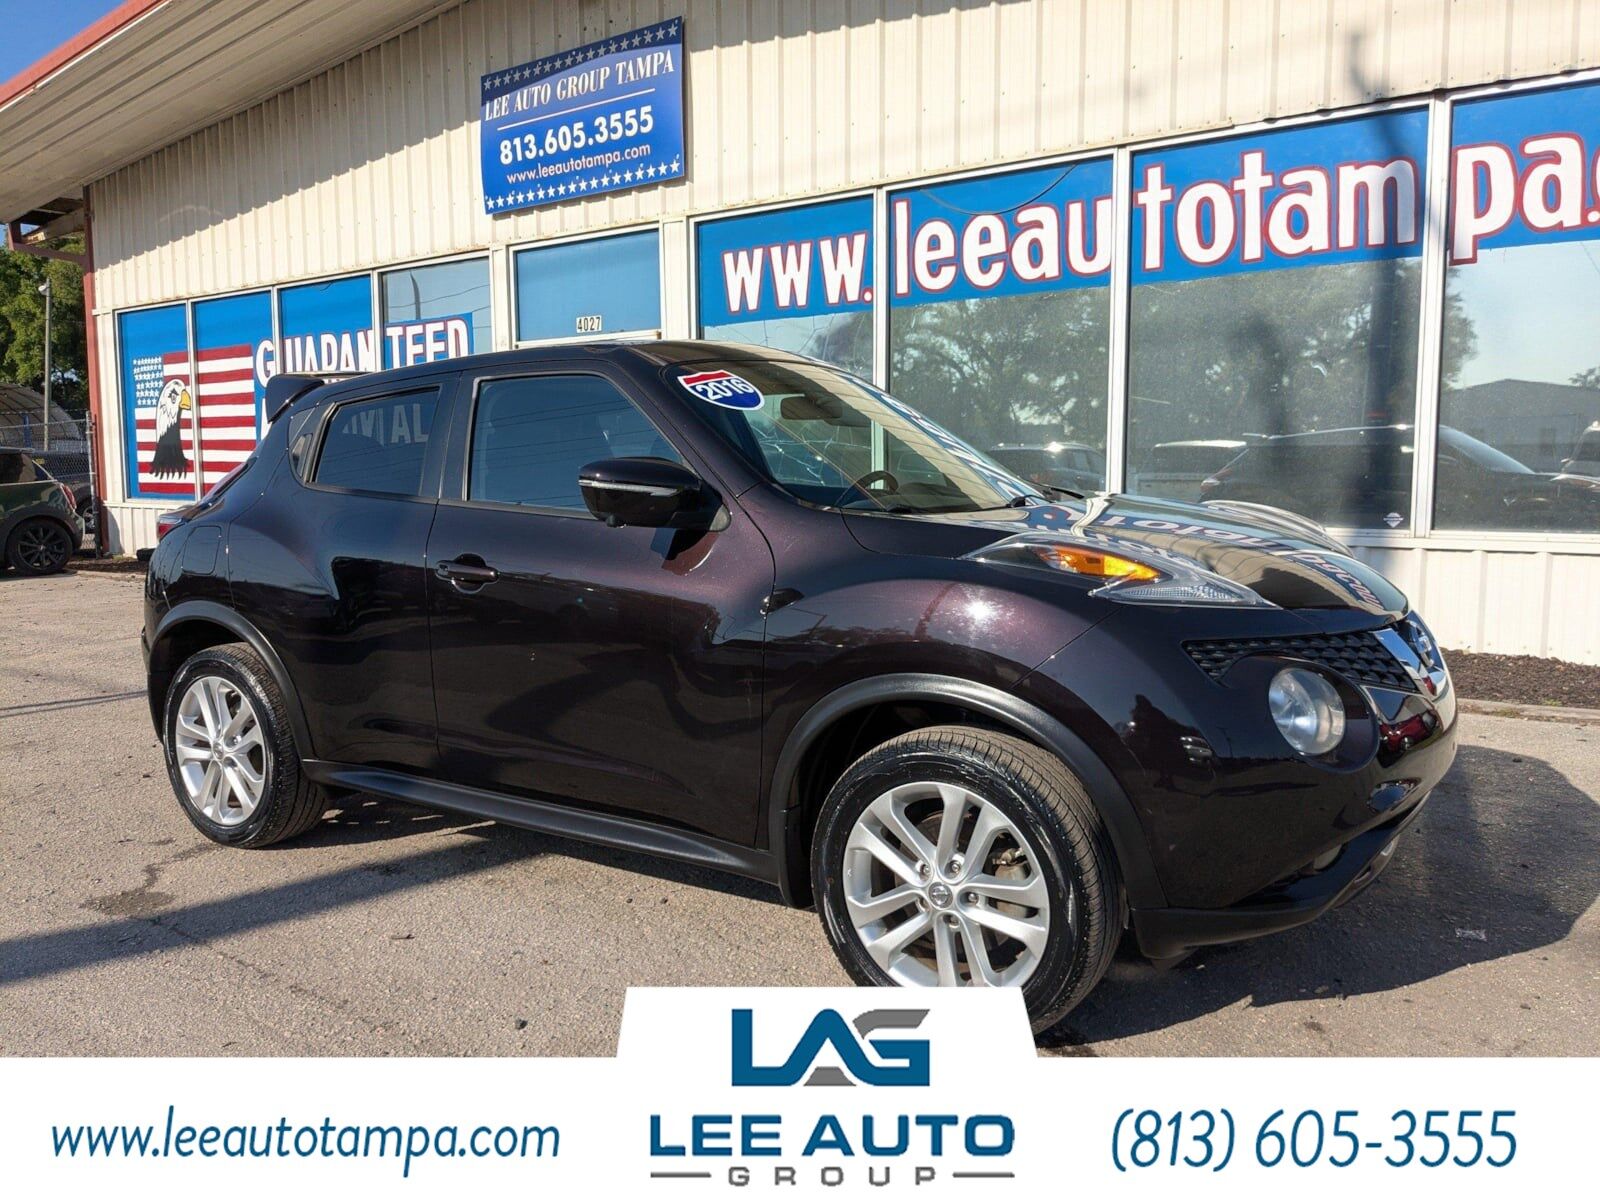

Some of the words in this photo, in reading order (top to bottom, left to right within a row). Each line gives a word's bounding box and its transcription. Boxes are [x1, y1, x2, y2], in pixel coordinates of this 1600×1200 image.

[484, 94, 510, 121] LEE
[513, 82, 552, 113] AUTO
[556, 66, 611, 101] GROUP
[615, 49, 675, 85] TAMPA
[499, 105, 654, 165] 813.605.3555
[506, 144, 651, 184] www.leeautotampa.com
[577, 316, 601, 332] 4027
[695, 378, 755, 401] 2016
